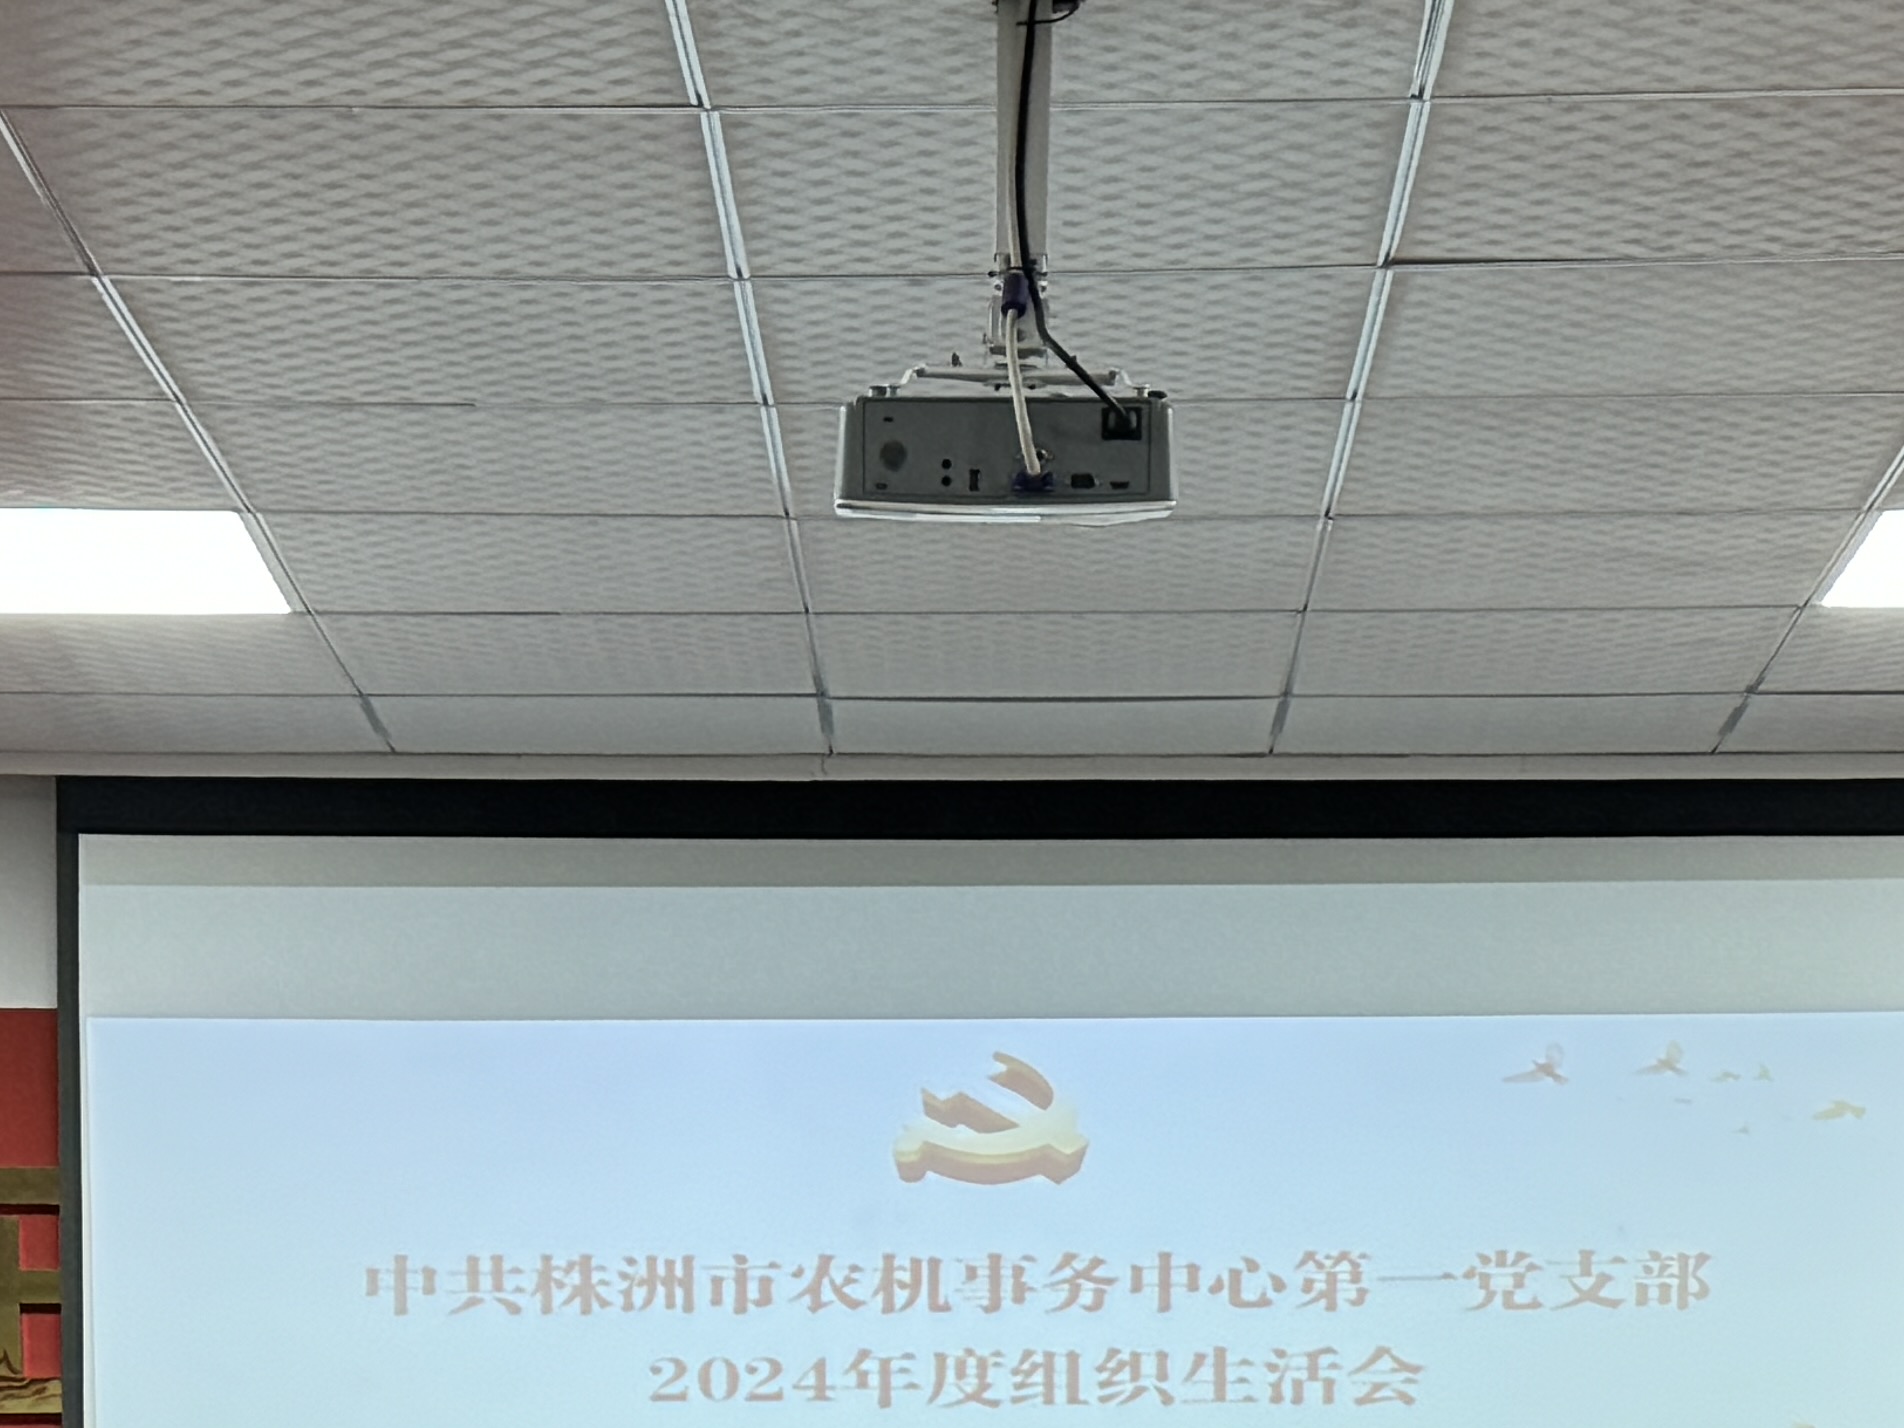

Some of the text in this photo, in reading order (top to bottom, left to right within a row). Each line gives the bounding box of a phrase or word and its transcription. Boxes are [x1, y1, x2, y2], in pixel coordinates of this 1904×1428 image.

[363, 1251, 1712, 1314] 中共株洲市农机事务中心第一党支部
[649, 1345, 1426, 1408] 2024年度组织生活会
